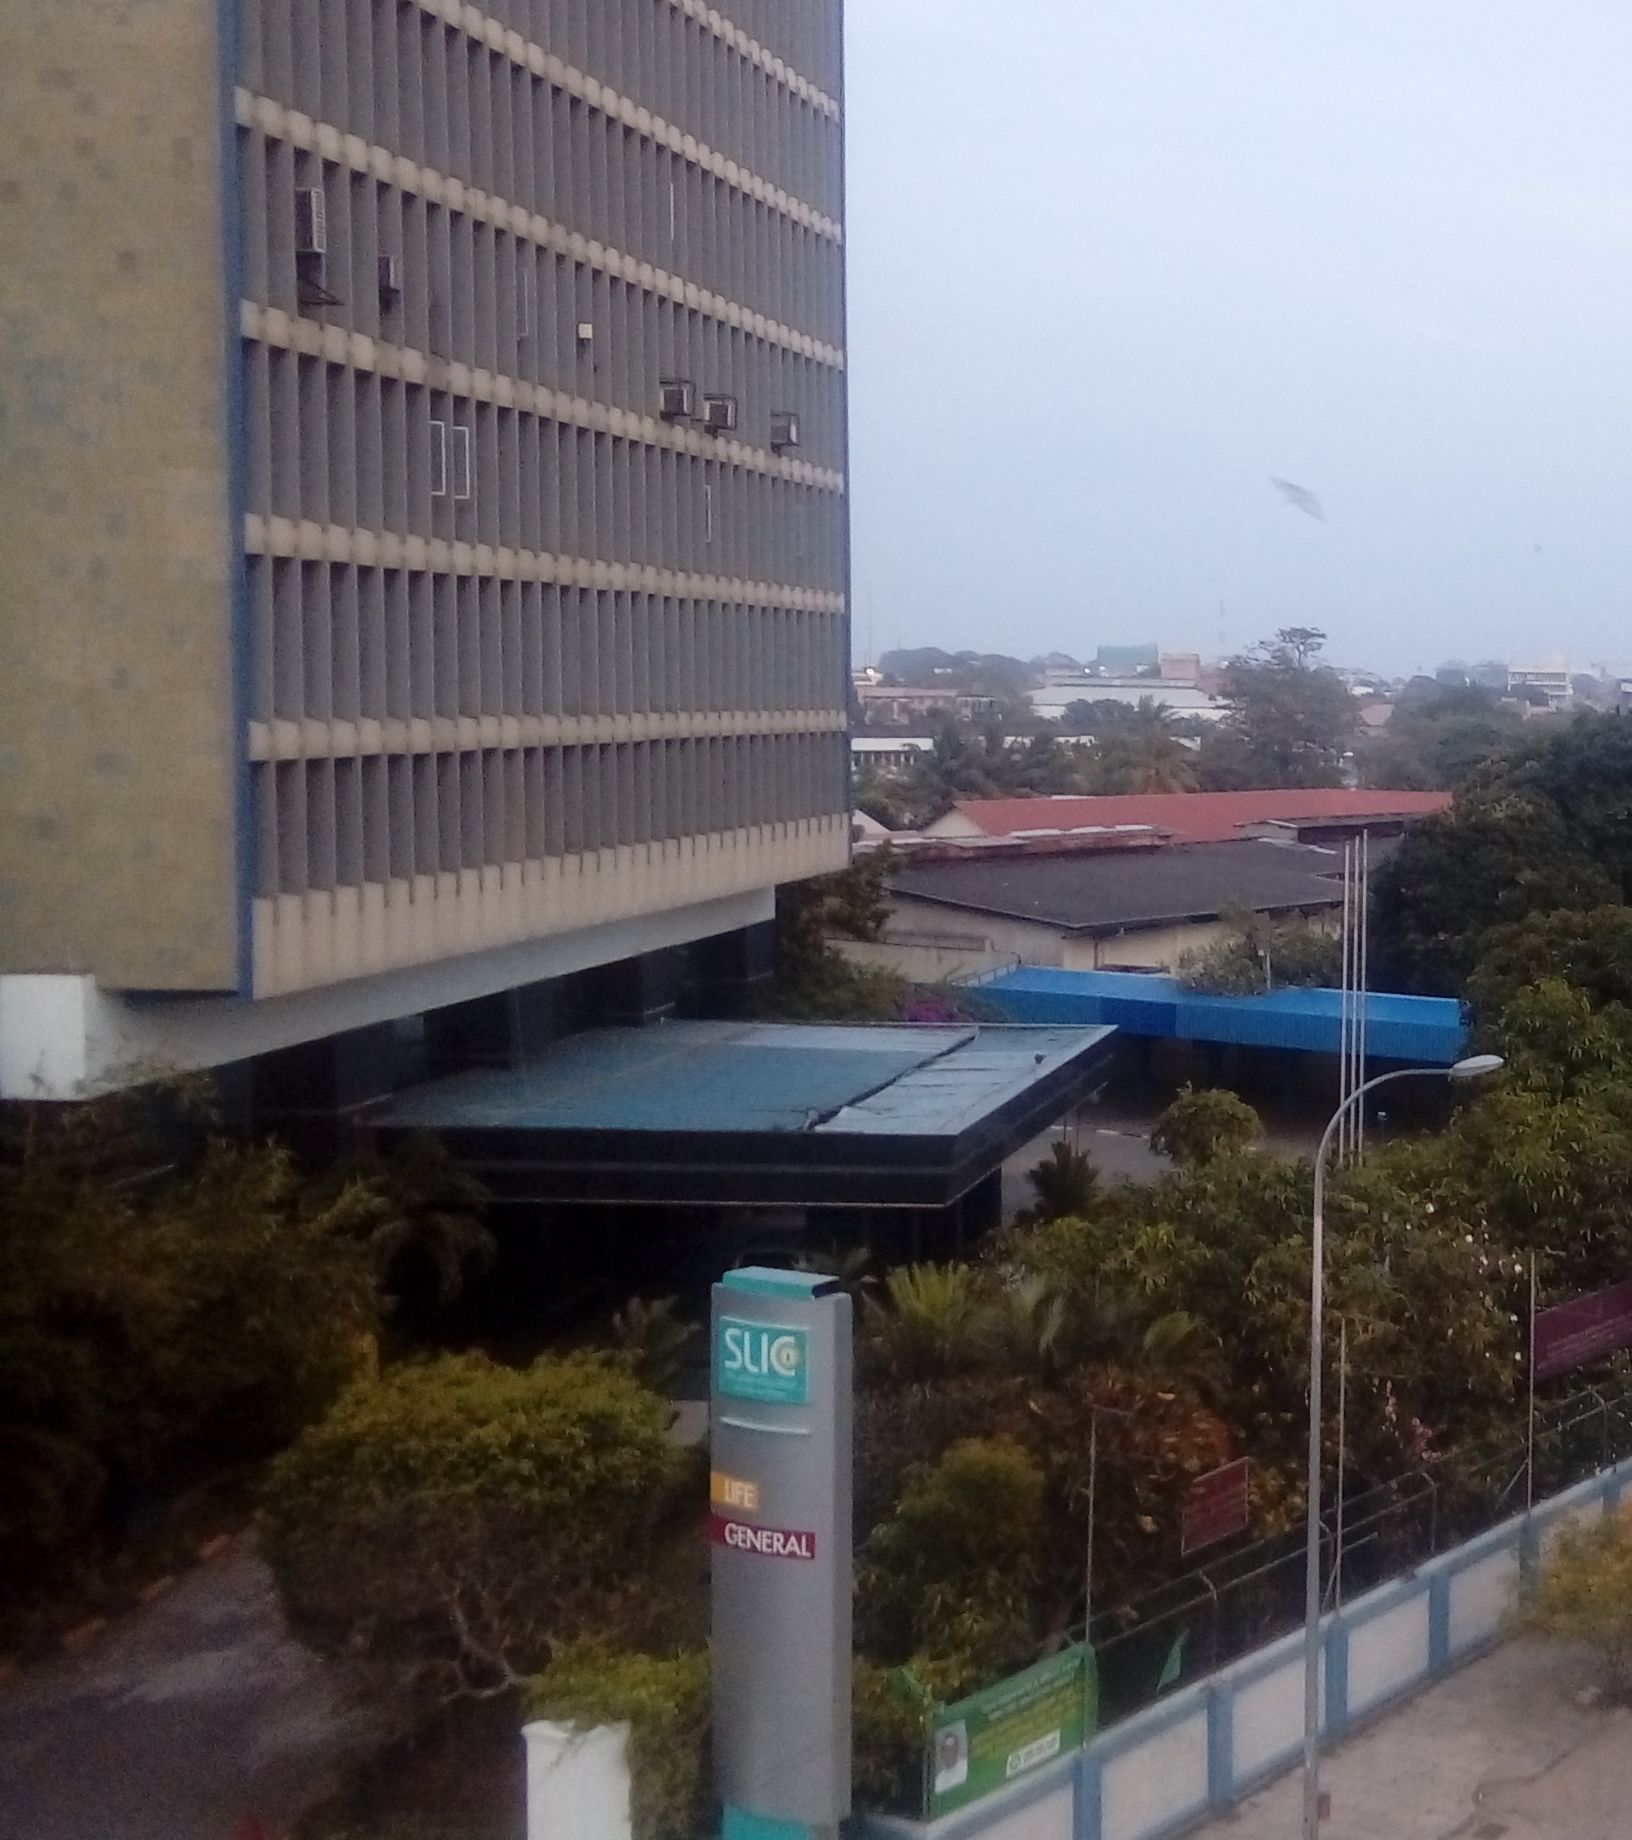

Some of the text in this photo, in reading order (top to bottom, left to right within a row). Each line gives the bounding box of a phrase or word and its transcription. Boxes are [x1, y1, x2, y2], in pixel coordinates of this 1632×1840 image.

[724, 1327, 797, 1376] SLIC
[724, 1480, 757, 1508] LIFE
[724, 1521, 812, 1558] GENERAL
